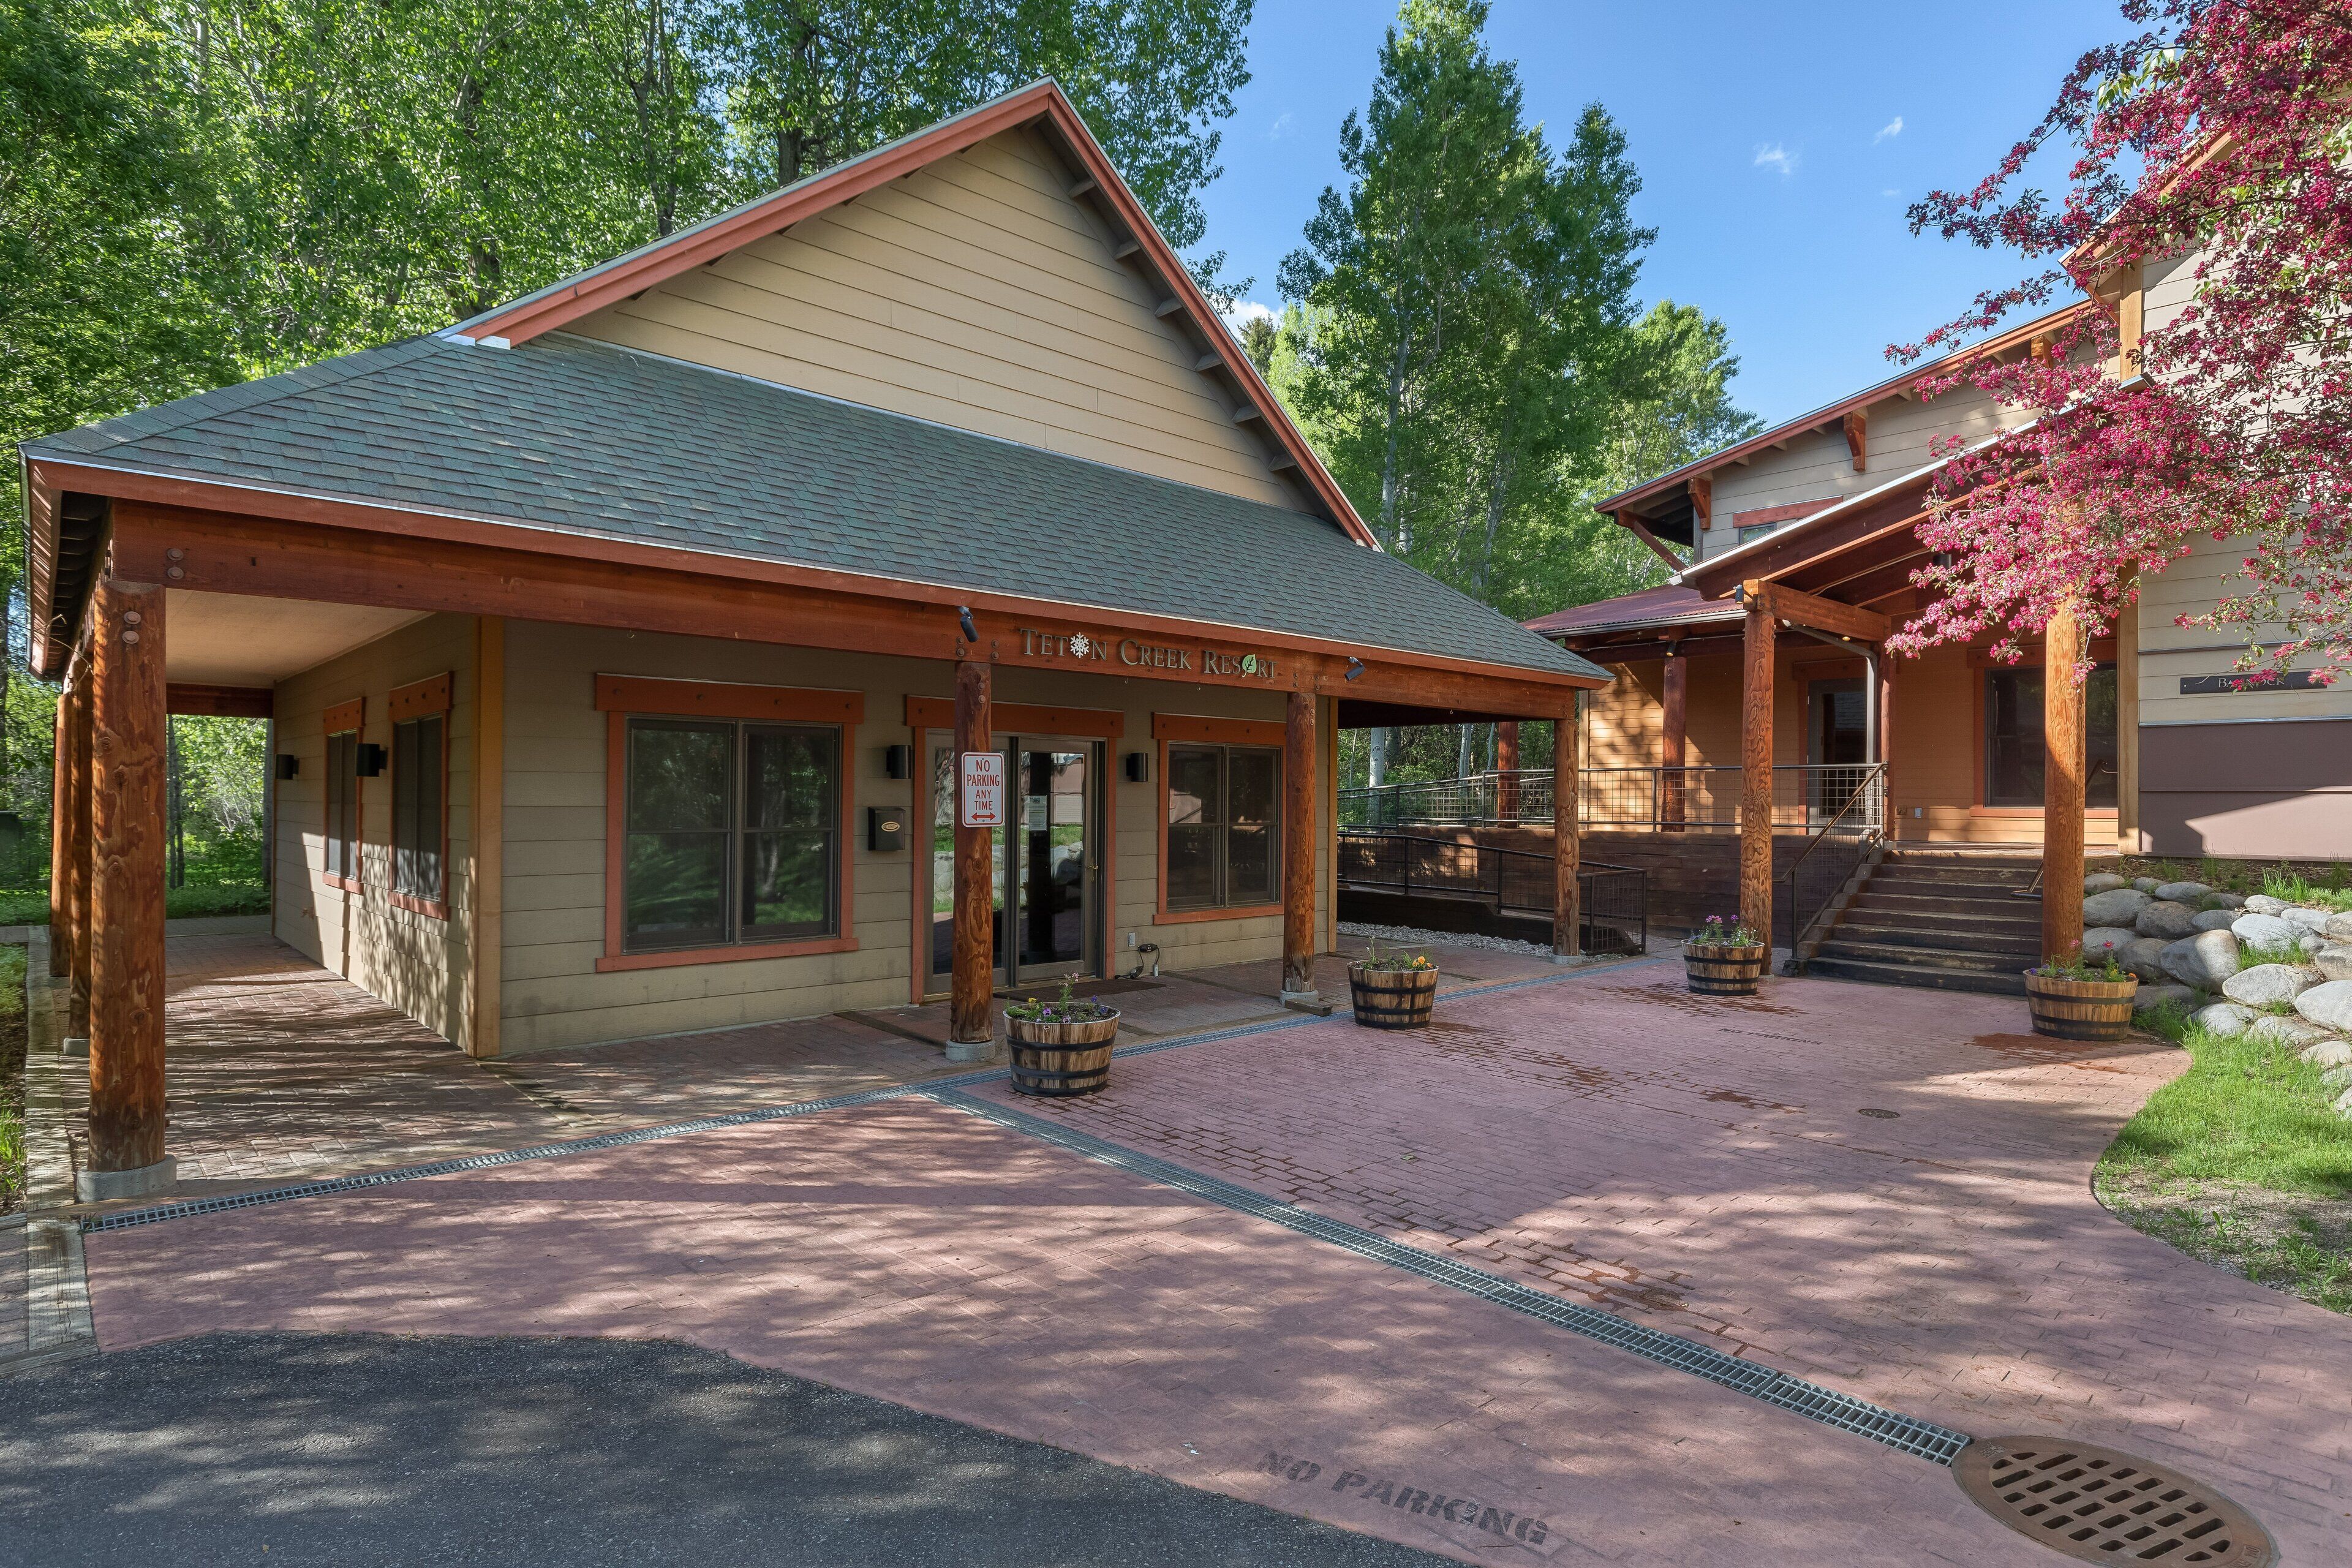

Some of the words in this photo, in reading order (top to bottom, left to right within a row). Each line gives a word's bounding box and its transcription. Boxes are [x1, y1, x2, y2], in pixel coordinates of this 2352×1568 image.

[1120, 639, 1193, 669] CREEK
[2218, 677, 2285, 688] BACK
[976, 760, 990, 772] NO
[967, 774, 1000, 786] PARKING
[976, 790, 992, 799] ANY
[974, 801, 993, 810] TIME
[1747, 1032, 1823, 1045] PARKING
[1255, 1450, 1321, 1483] NO
[1331, 1471, 1548, 1545] PARKING
